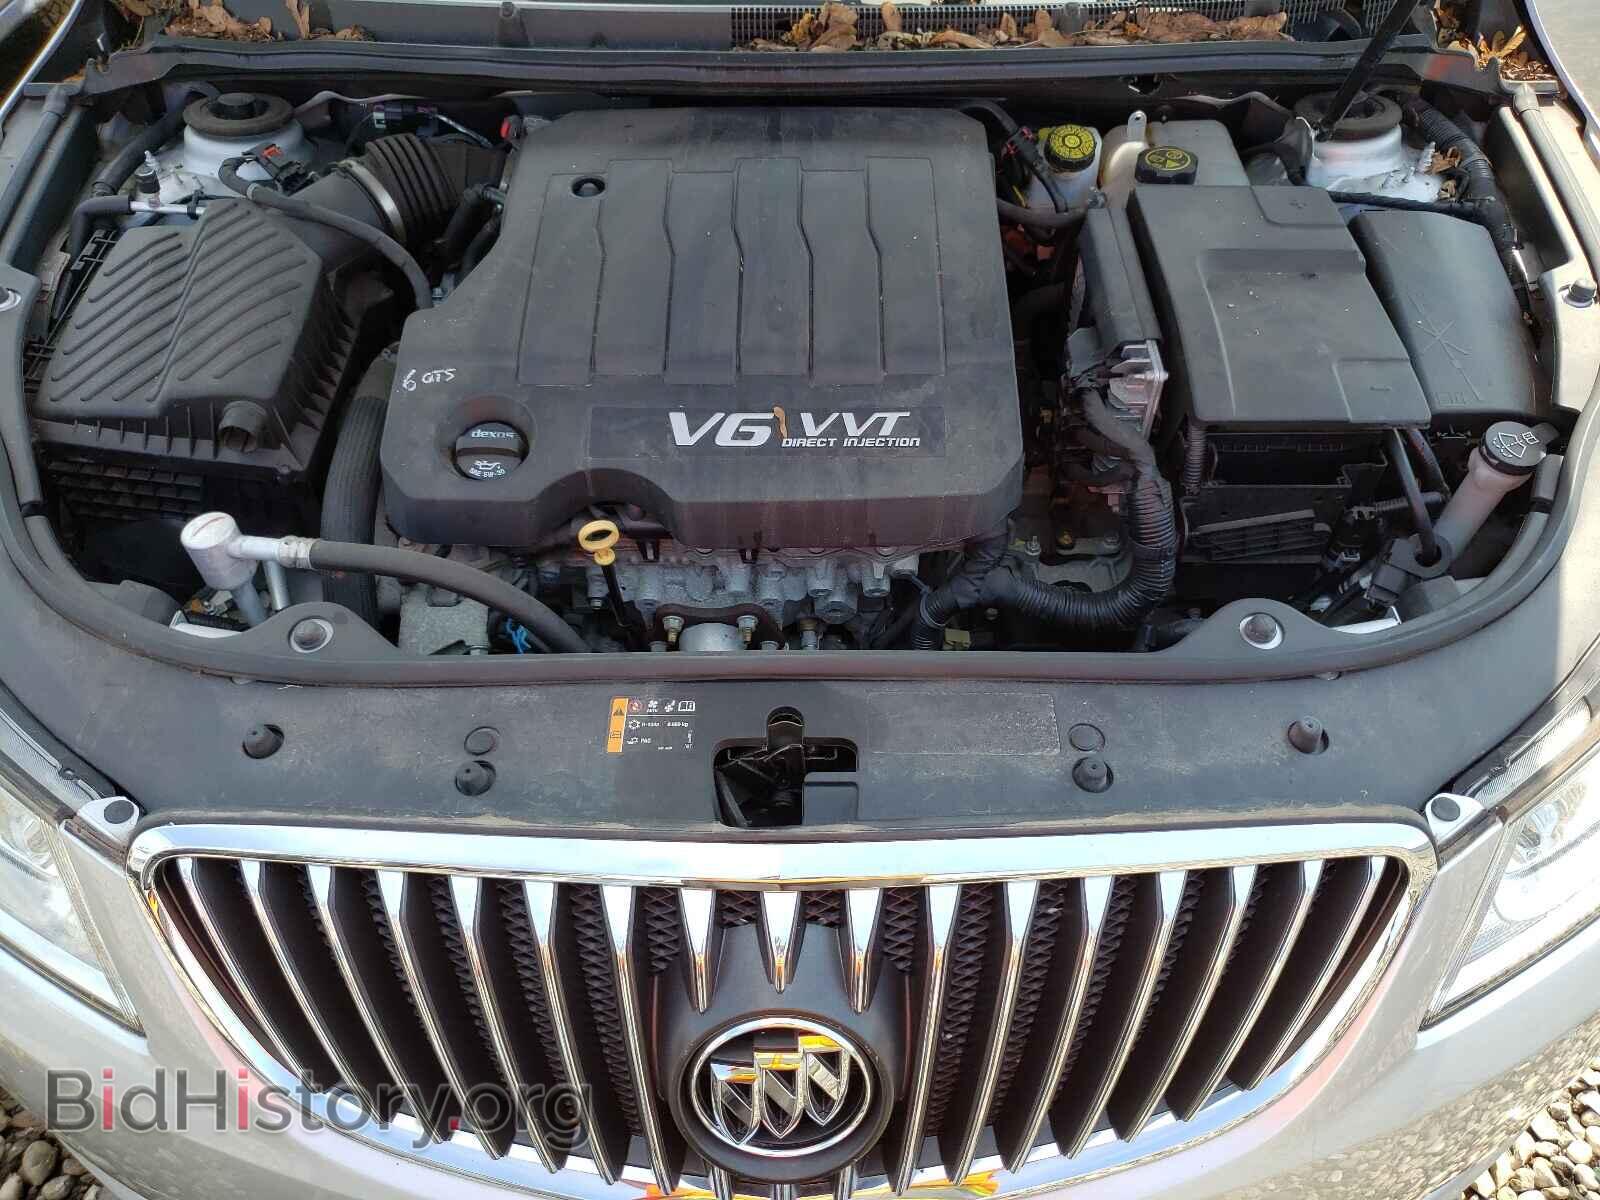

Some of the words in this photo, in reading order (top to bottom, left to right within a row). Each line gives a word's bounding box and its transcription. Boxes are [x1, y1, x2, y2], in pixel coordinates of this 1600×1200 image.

[402, 369, 417, 391] 6
[799, 411, 911, 437] VVT
[781, 437, 838, 448] DIRECT
[842, 437, 921, 448] INJECTION
